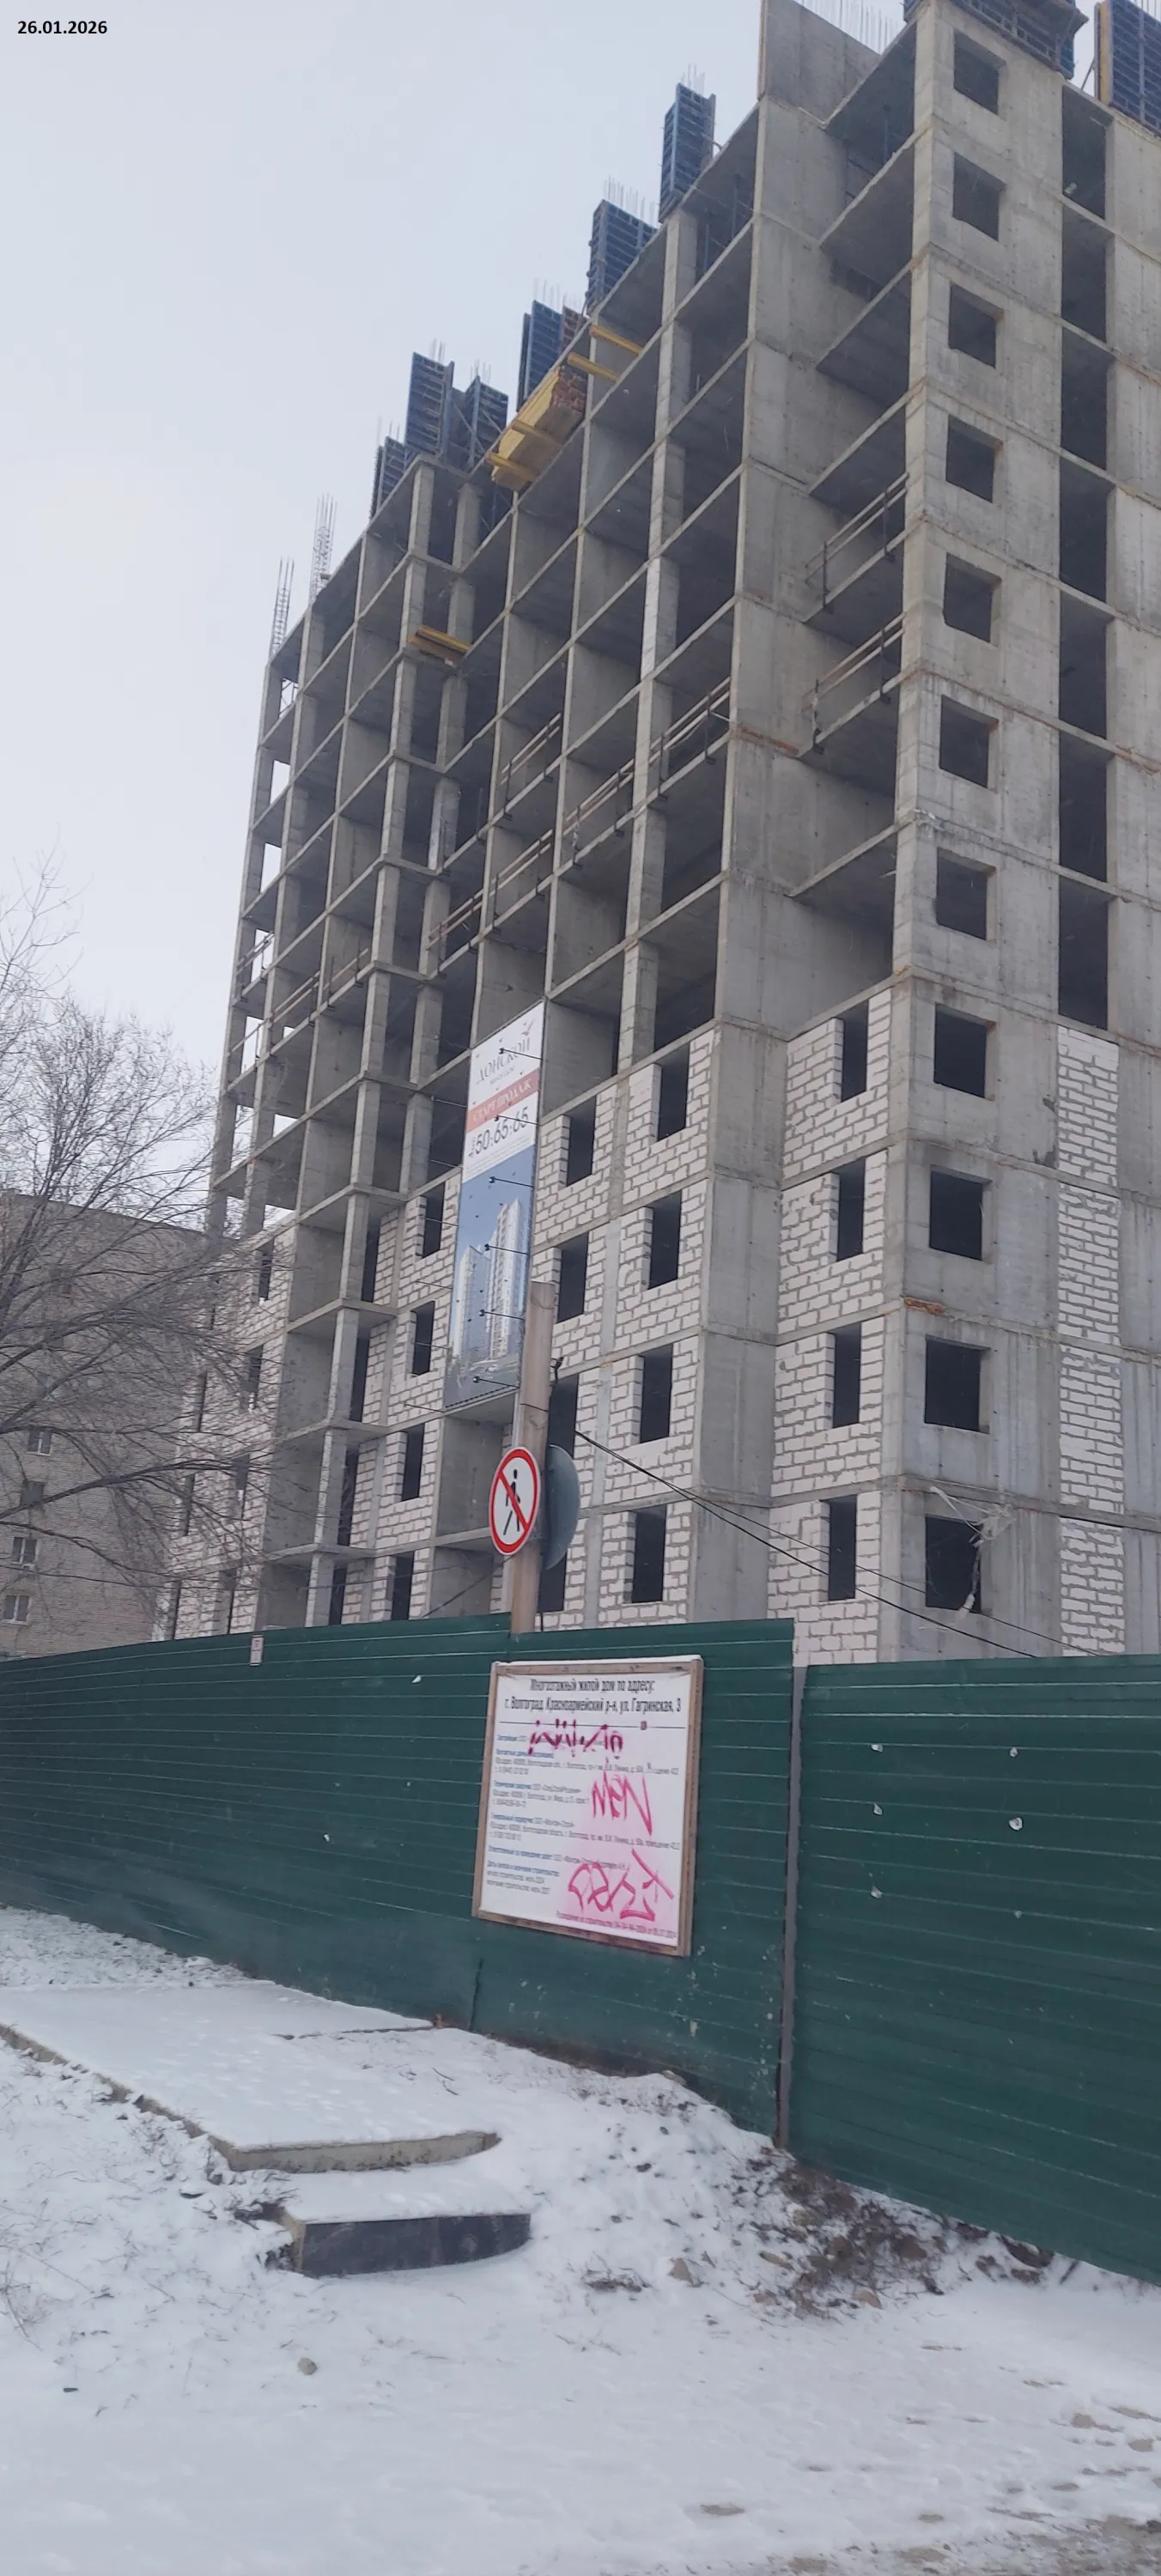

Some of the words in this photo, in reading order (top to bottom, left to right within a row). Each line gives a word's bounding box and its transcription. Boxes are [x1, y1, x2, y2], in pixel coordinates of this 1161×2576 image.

[578, 1678, 599, 1692] жилой
[601, 1680, 615, 1692] дом
[617, 1680, 625, 1692] по
[546, 1697, 604, 1714] Красноармейский
